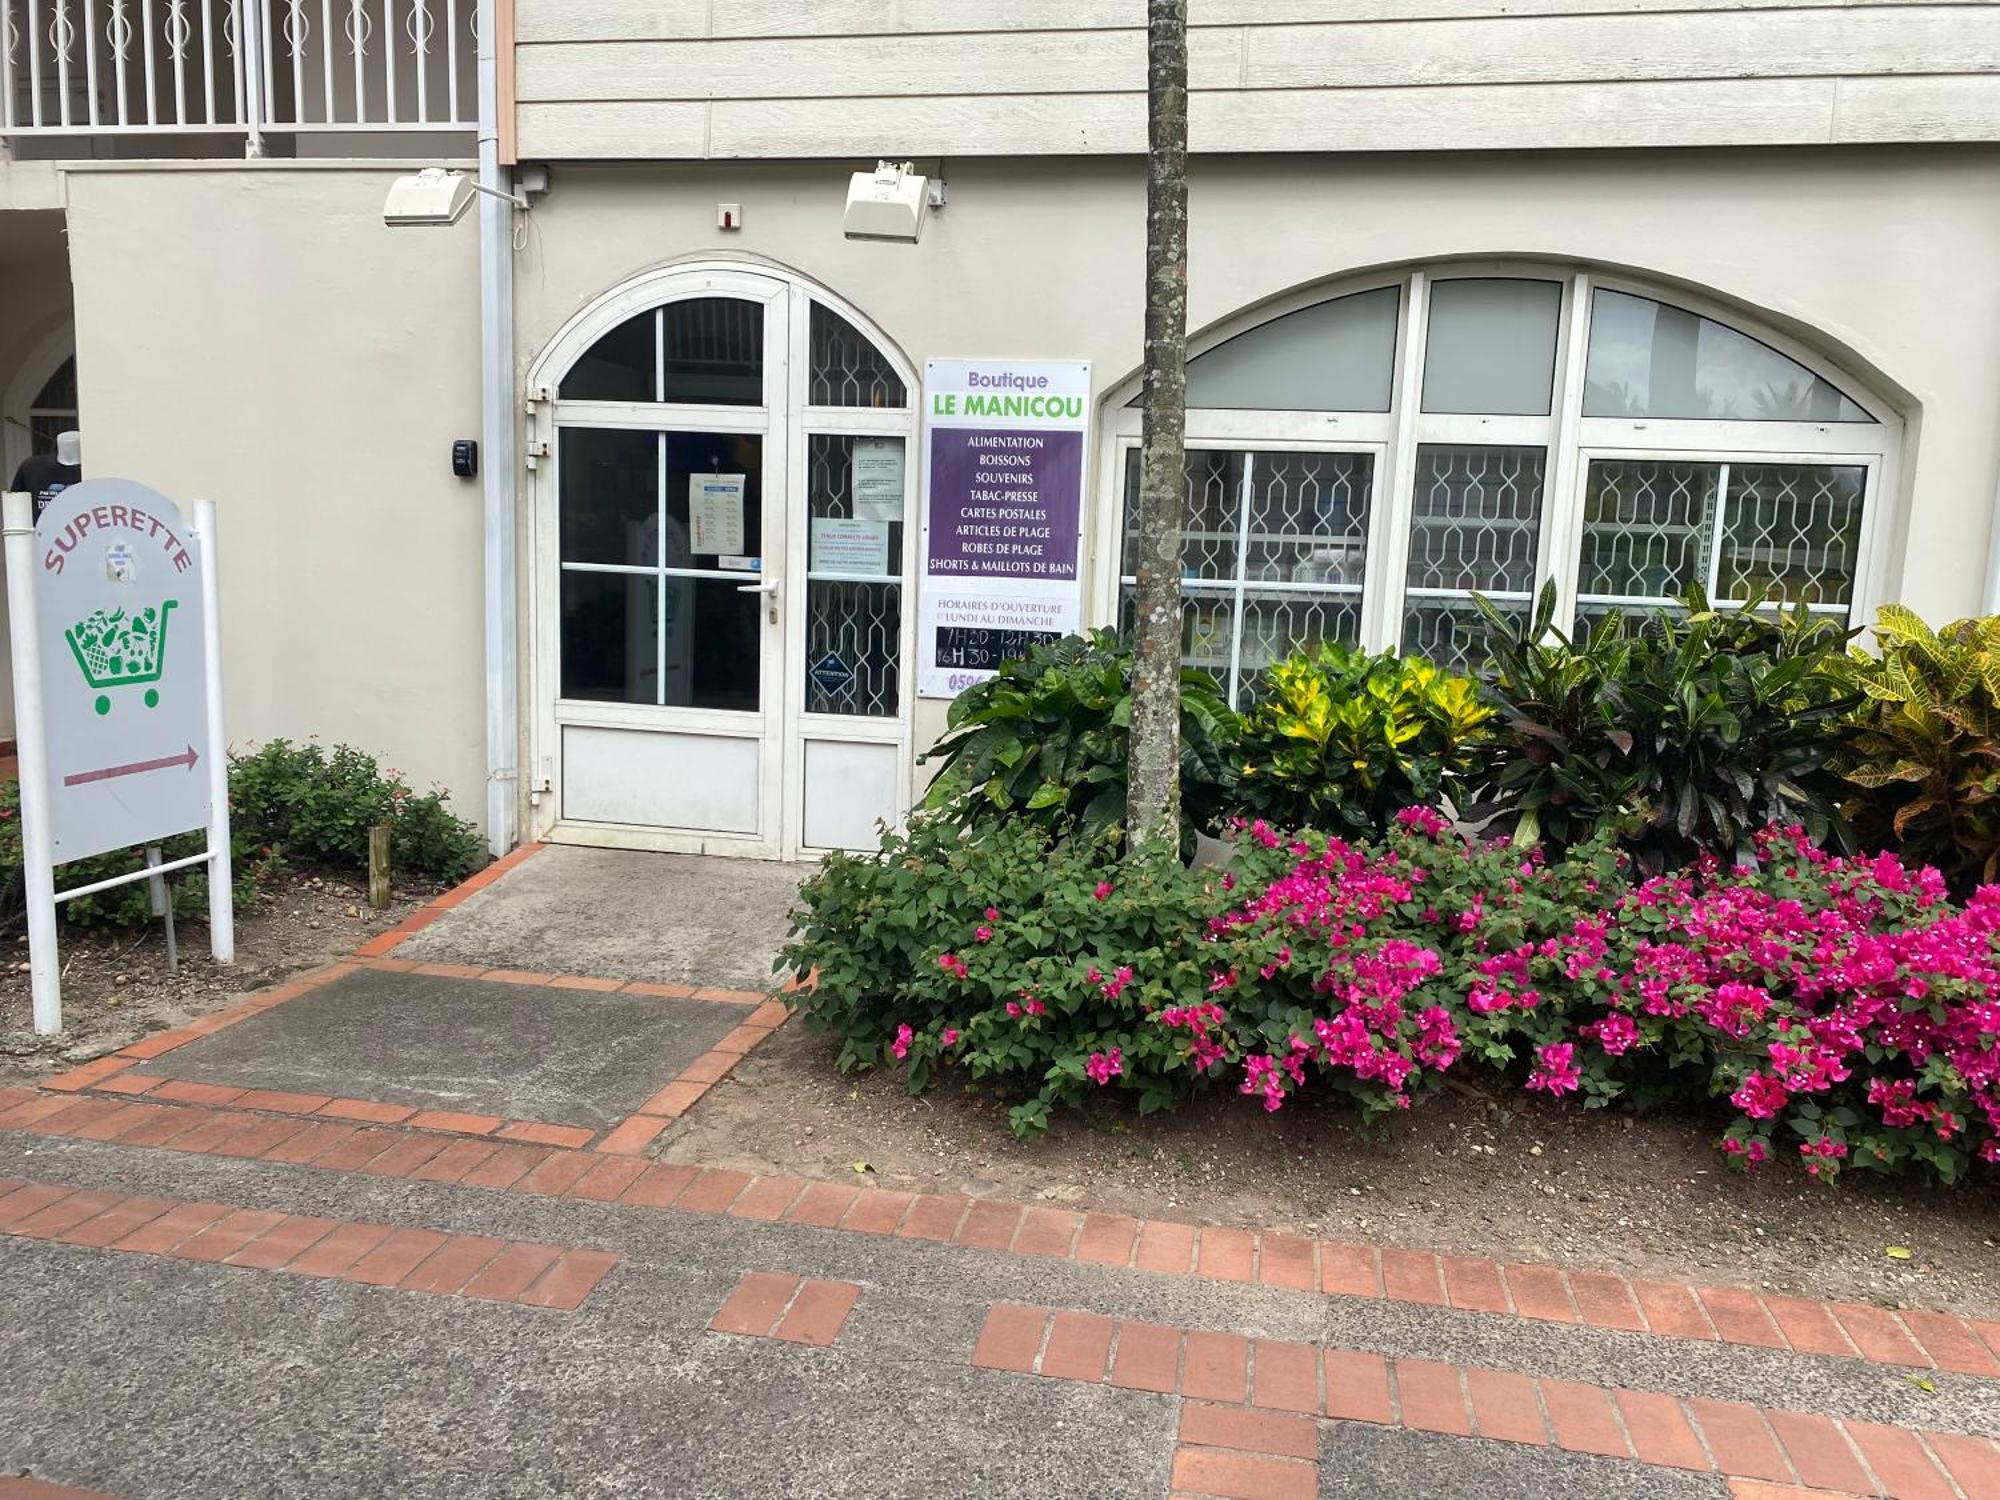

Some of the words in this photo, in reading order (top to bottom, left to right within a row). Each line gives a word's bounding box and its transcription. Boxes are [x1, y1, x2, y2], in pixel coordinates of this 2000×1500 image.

[968, 372, 1048, 390] Boutique
[933, 394, 956, 415] LE
[964, 396, 1082, 418] MANICOU
[968, 437, 1044, 449] ALIMENTATION
[979, 455, 1031, 466] BOISSONS
[975, 472, 1033, 484] SOUVENIRS
[961, 508, 996, 519] CARTES
[999, 509, 1046, 520] POSTALES
[956, 525, 1001, 537] ARTICLES
[1003, 527, 1016, 537] DE
[1018, 527, 1050, 538] PLAGE
[44, 505, 192, 575] SUPERETTE
[962, 543, 994, 554] ROBES
[996, 544, 1010, 554] DE
[1012, 545, 1043, 556] PLAGE
[930, 559, 969, 570] SHORTS
[971, 561, 979, 571] &
[981, 561, 1031, 573] MAILLOTS
[1033, 563, 1047, 573] DE
[1049, 563, 1074, 575] BAIN
[938, 600, 988, 611] HORAIRES
[990, 601, 1062, 614] D'OUVERTURE
[946, 612, 978, 624] LUNDI
[980, 614, 996, 625] AU
[998, 615, 1053, 627] DIMANCHE
